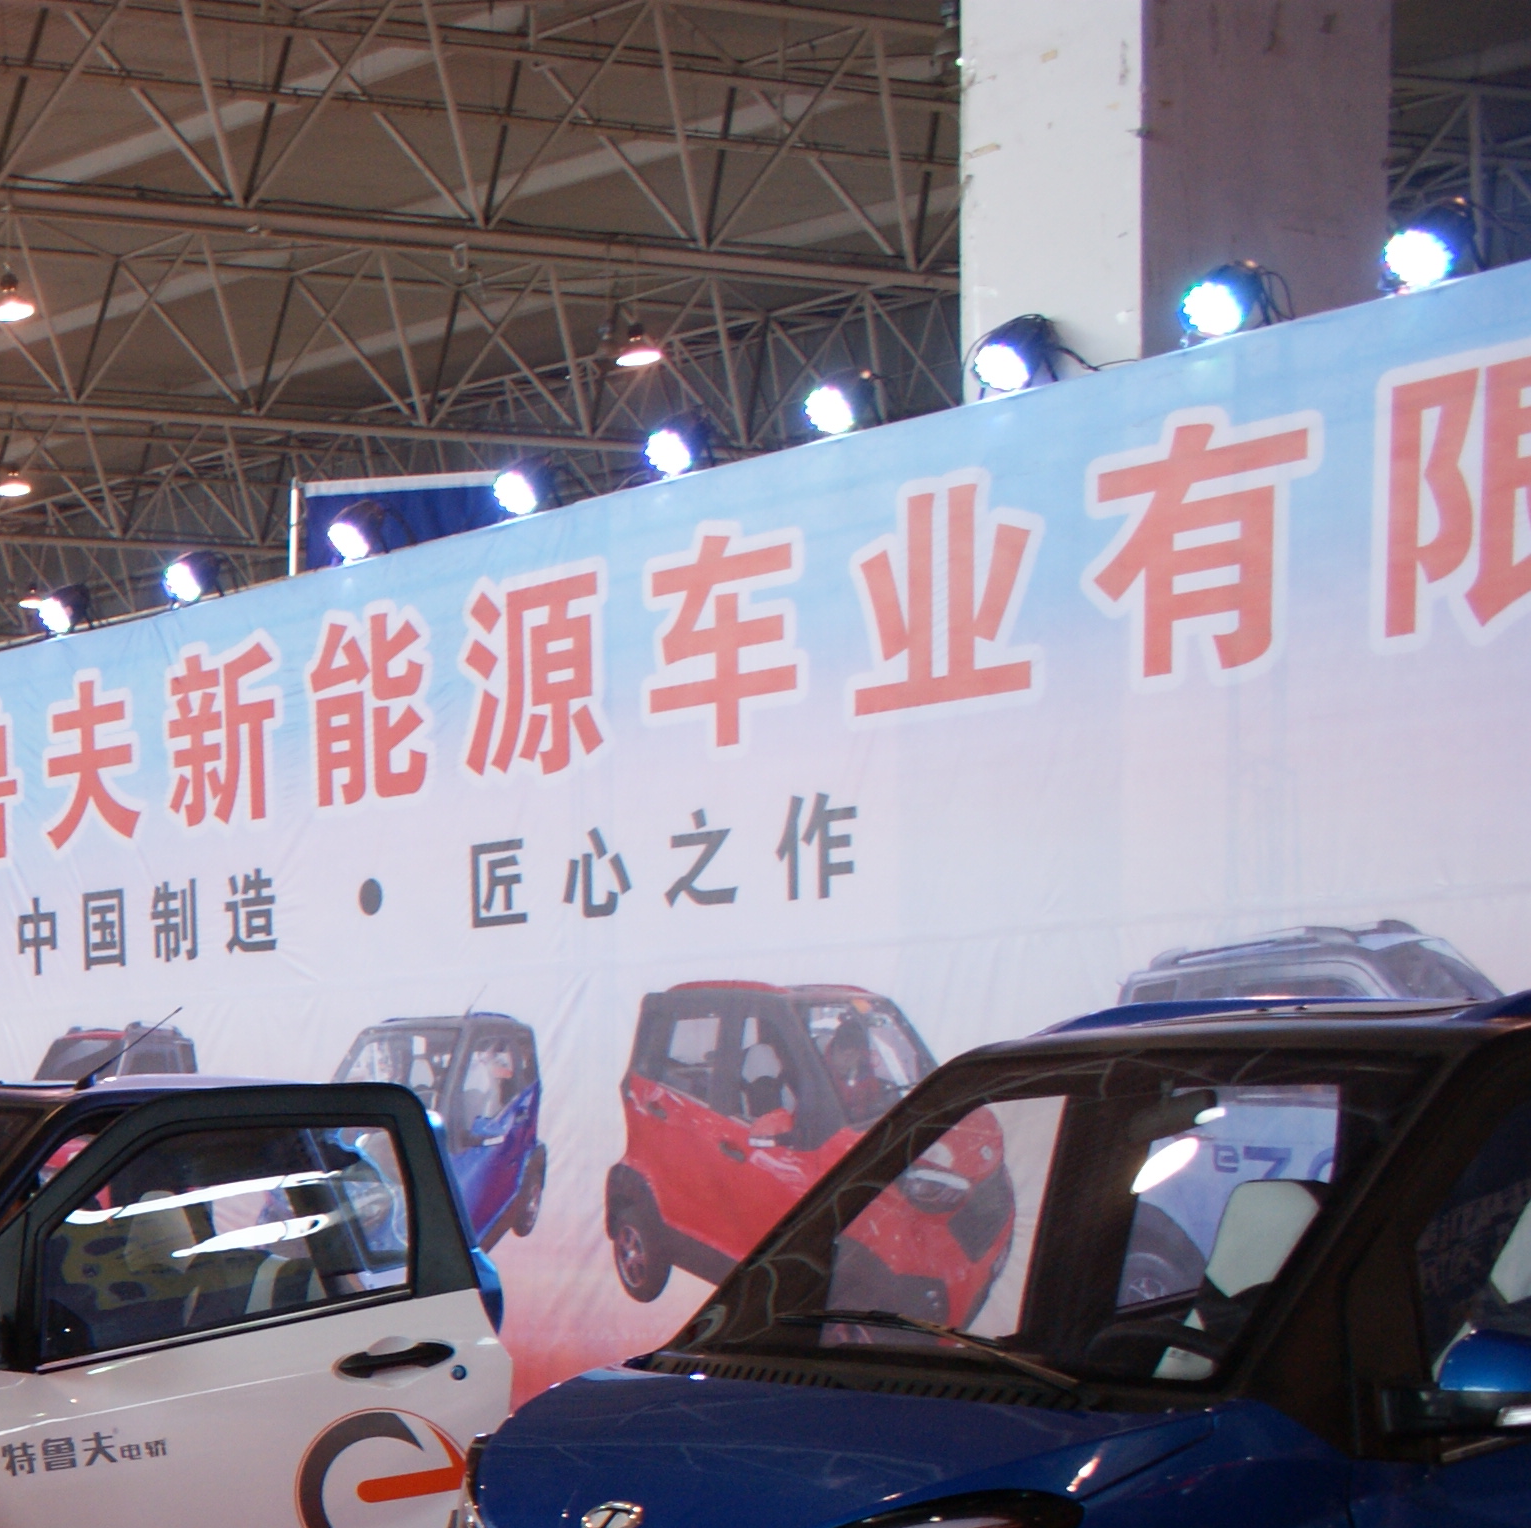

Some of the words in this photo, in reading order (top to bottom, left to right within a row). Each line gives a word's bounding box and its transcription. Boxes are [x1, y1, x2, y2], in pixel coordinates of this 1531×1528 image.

[17, 866, 278, 976] 中国制造
[470, 791, 858, 930] 匠心之作
